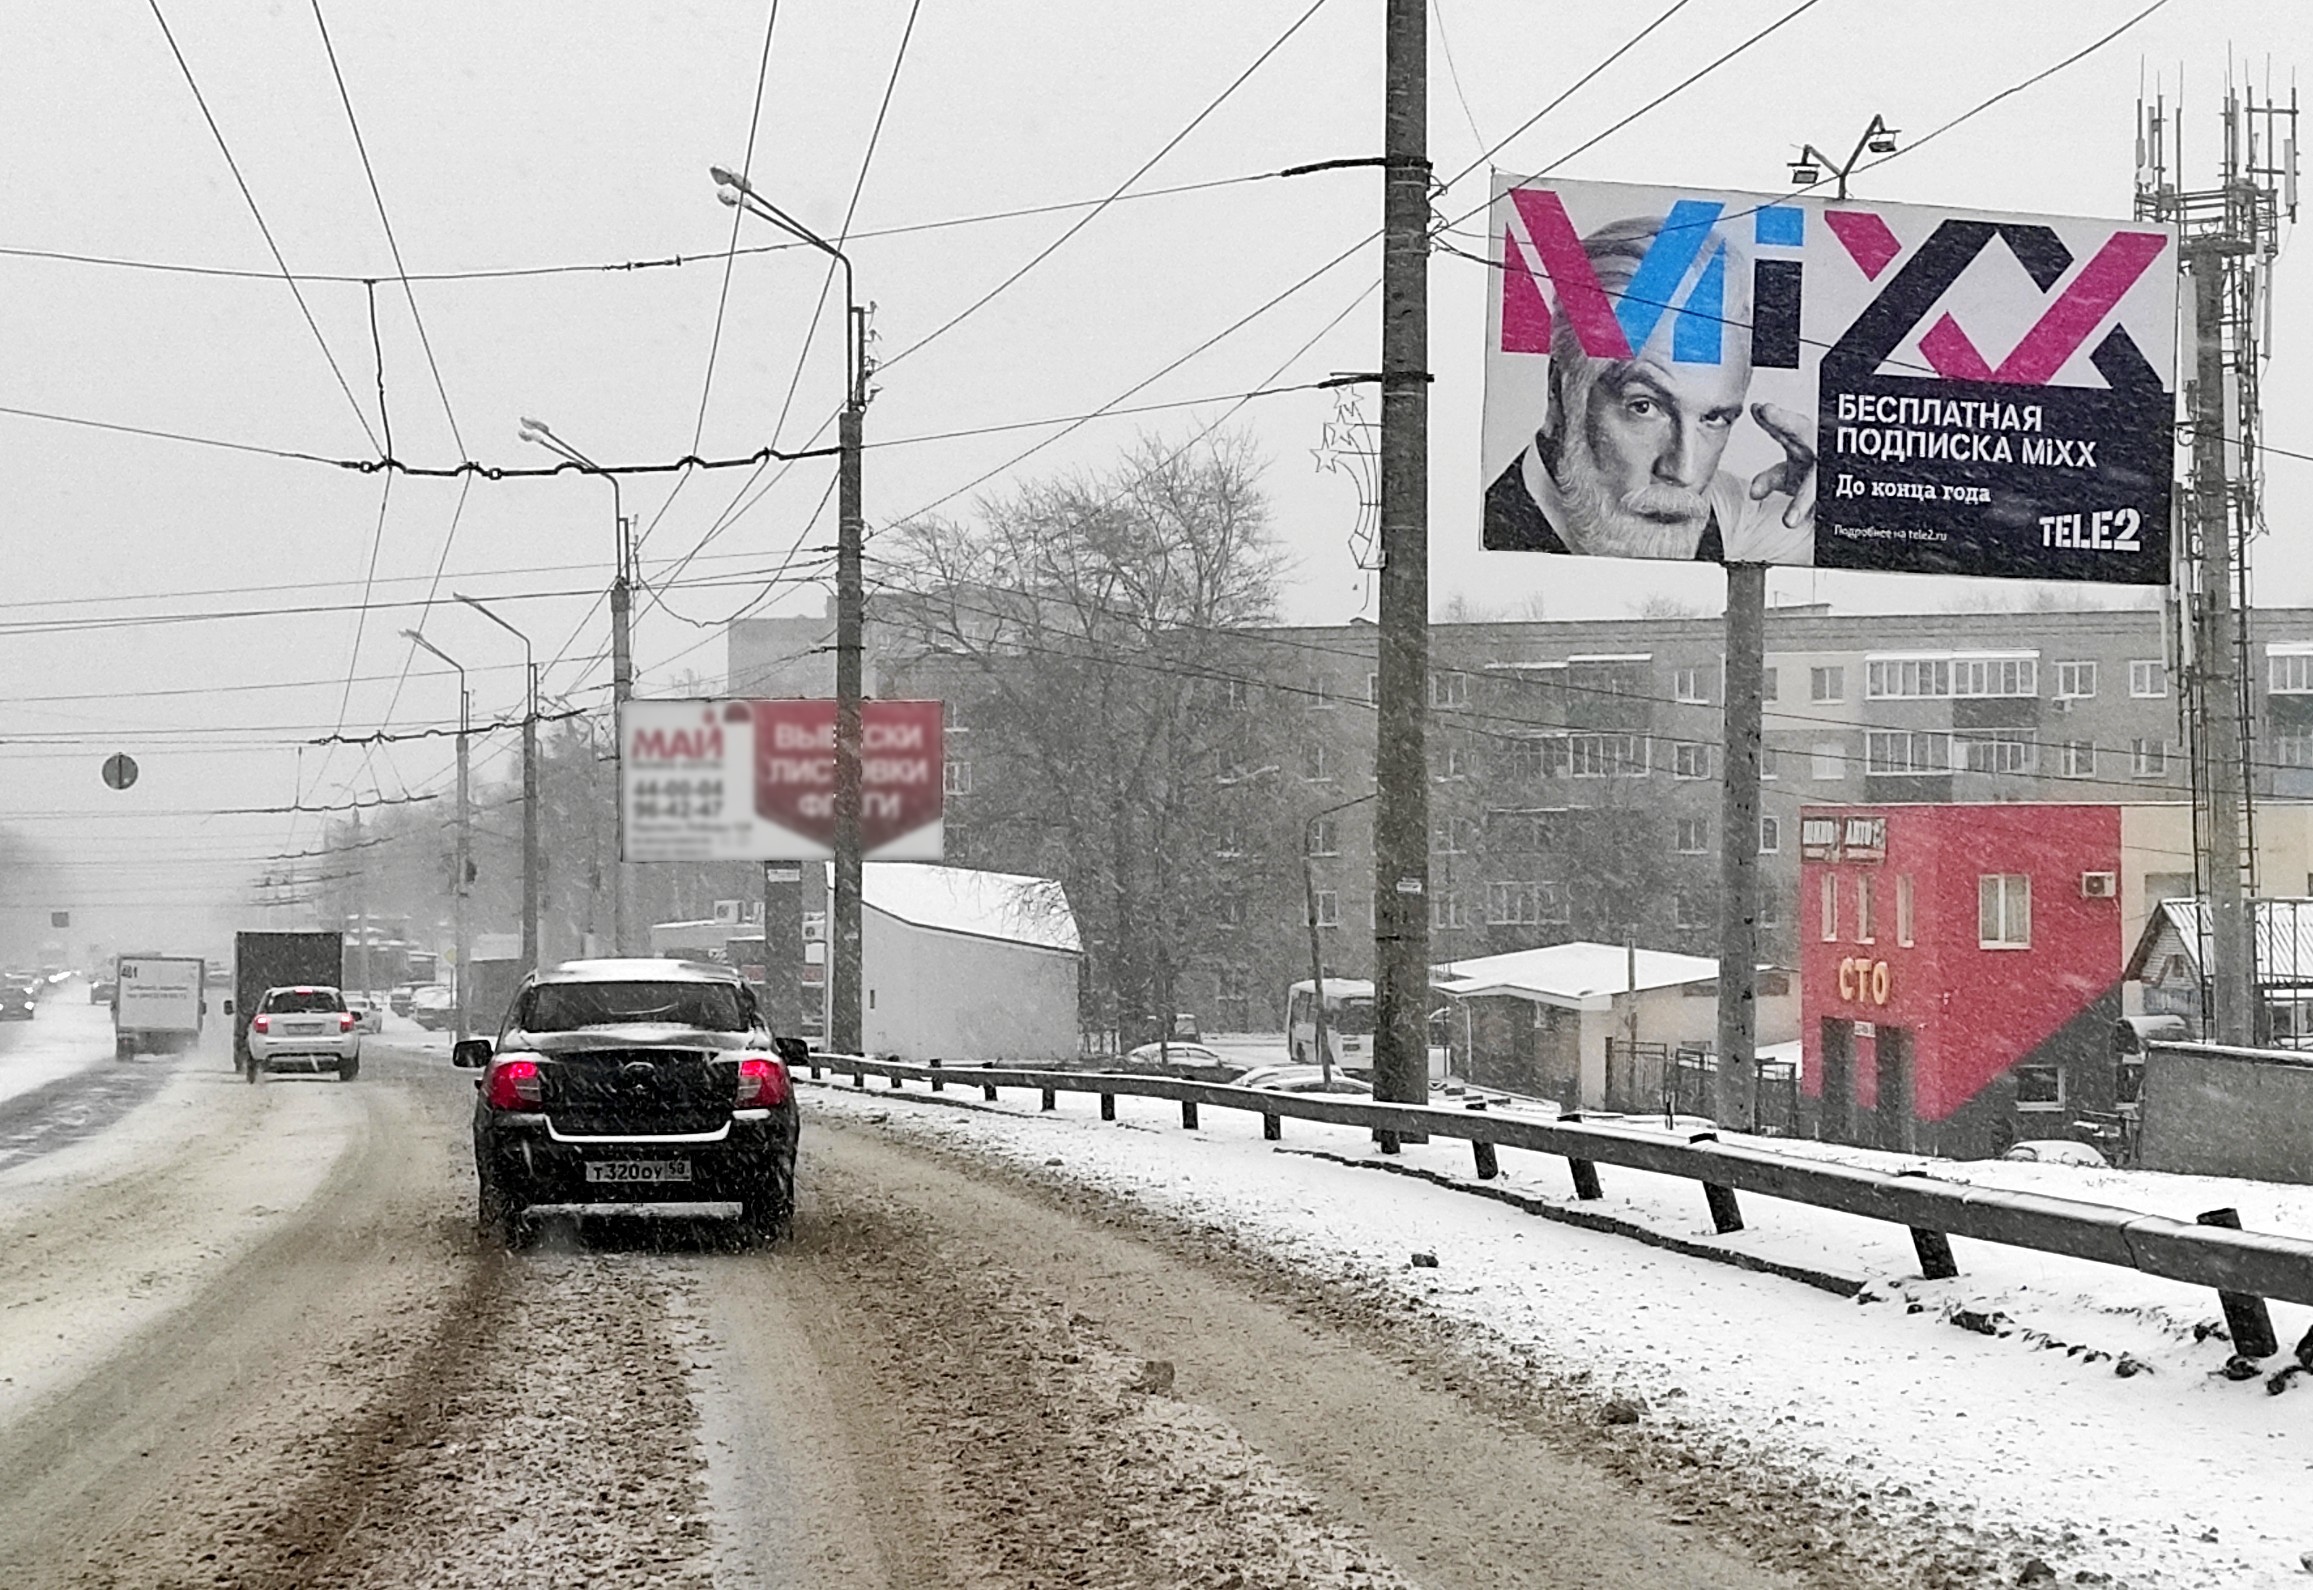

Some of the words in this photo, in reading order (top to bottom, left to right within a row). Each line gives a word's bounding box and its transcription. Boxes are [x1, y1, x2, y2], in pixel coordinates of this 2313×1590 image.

[1837, 393, 2042, 432] БЕСПЛАТНАЯ
[1836, 427, 2014, 463] ПОДПИСКА
[1836, 474, 1866, 498] До
[1871, 481, 1937, 501] конца
[1942, 485, 1992, 504] года
[2039, 508, 2141, 551] TELE2
[1839, 957, 1890, 1005] СТО
